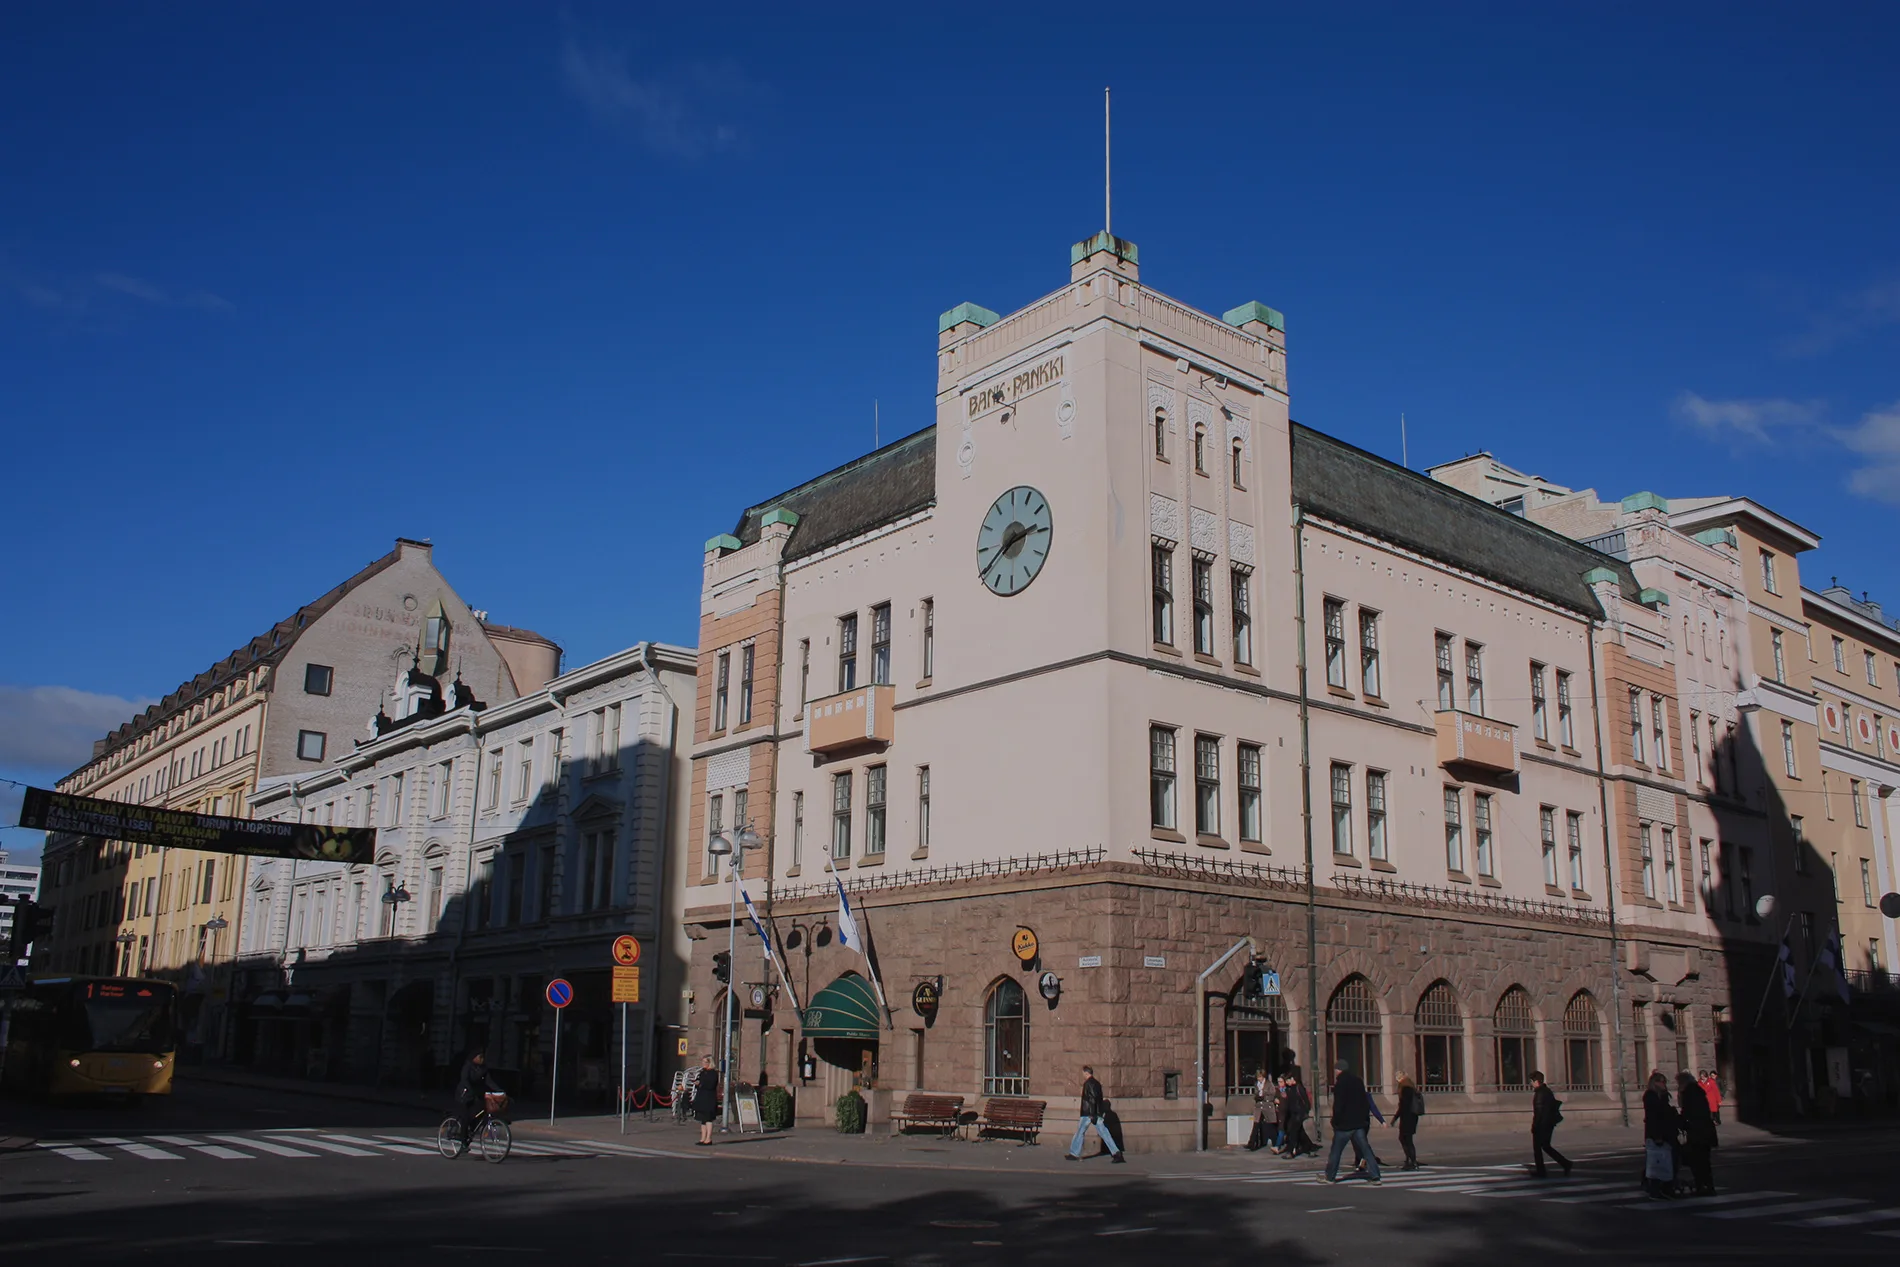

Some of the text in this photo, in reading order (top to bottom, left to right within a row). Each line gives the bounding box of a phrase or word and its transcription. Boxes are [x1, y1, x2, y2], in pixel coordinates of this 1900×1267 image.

[969, 355, 1063, 416] BANK PANKKI
[195, 816, 230, 831] TURUN
[233, 820, 292, 836] YLIOPISTON
[87, 983, 93, 999] 1
